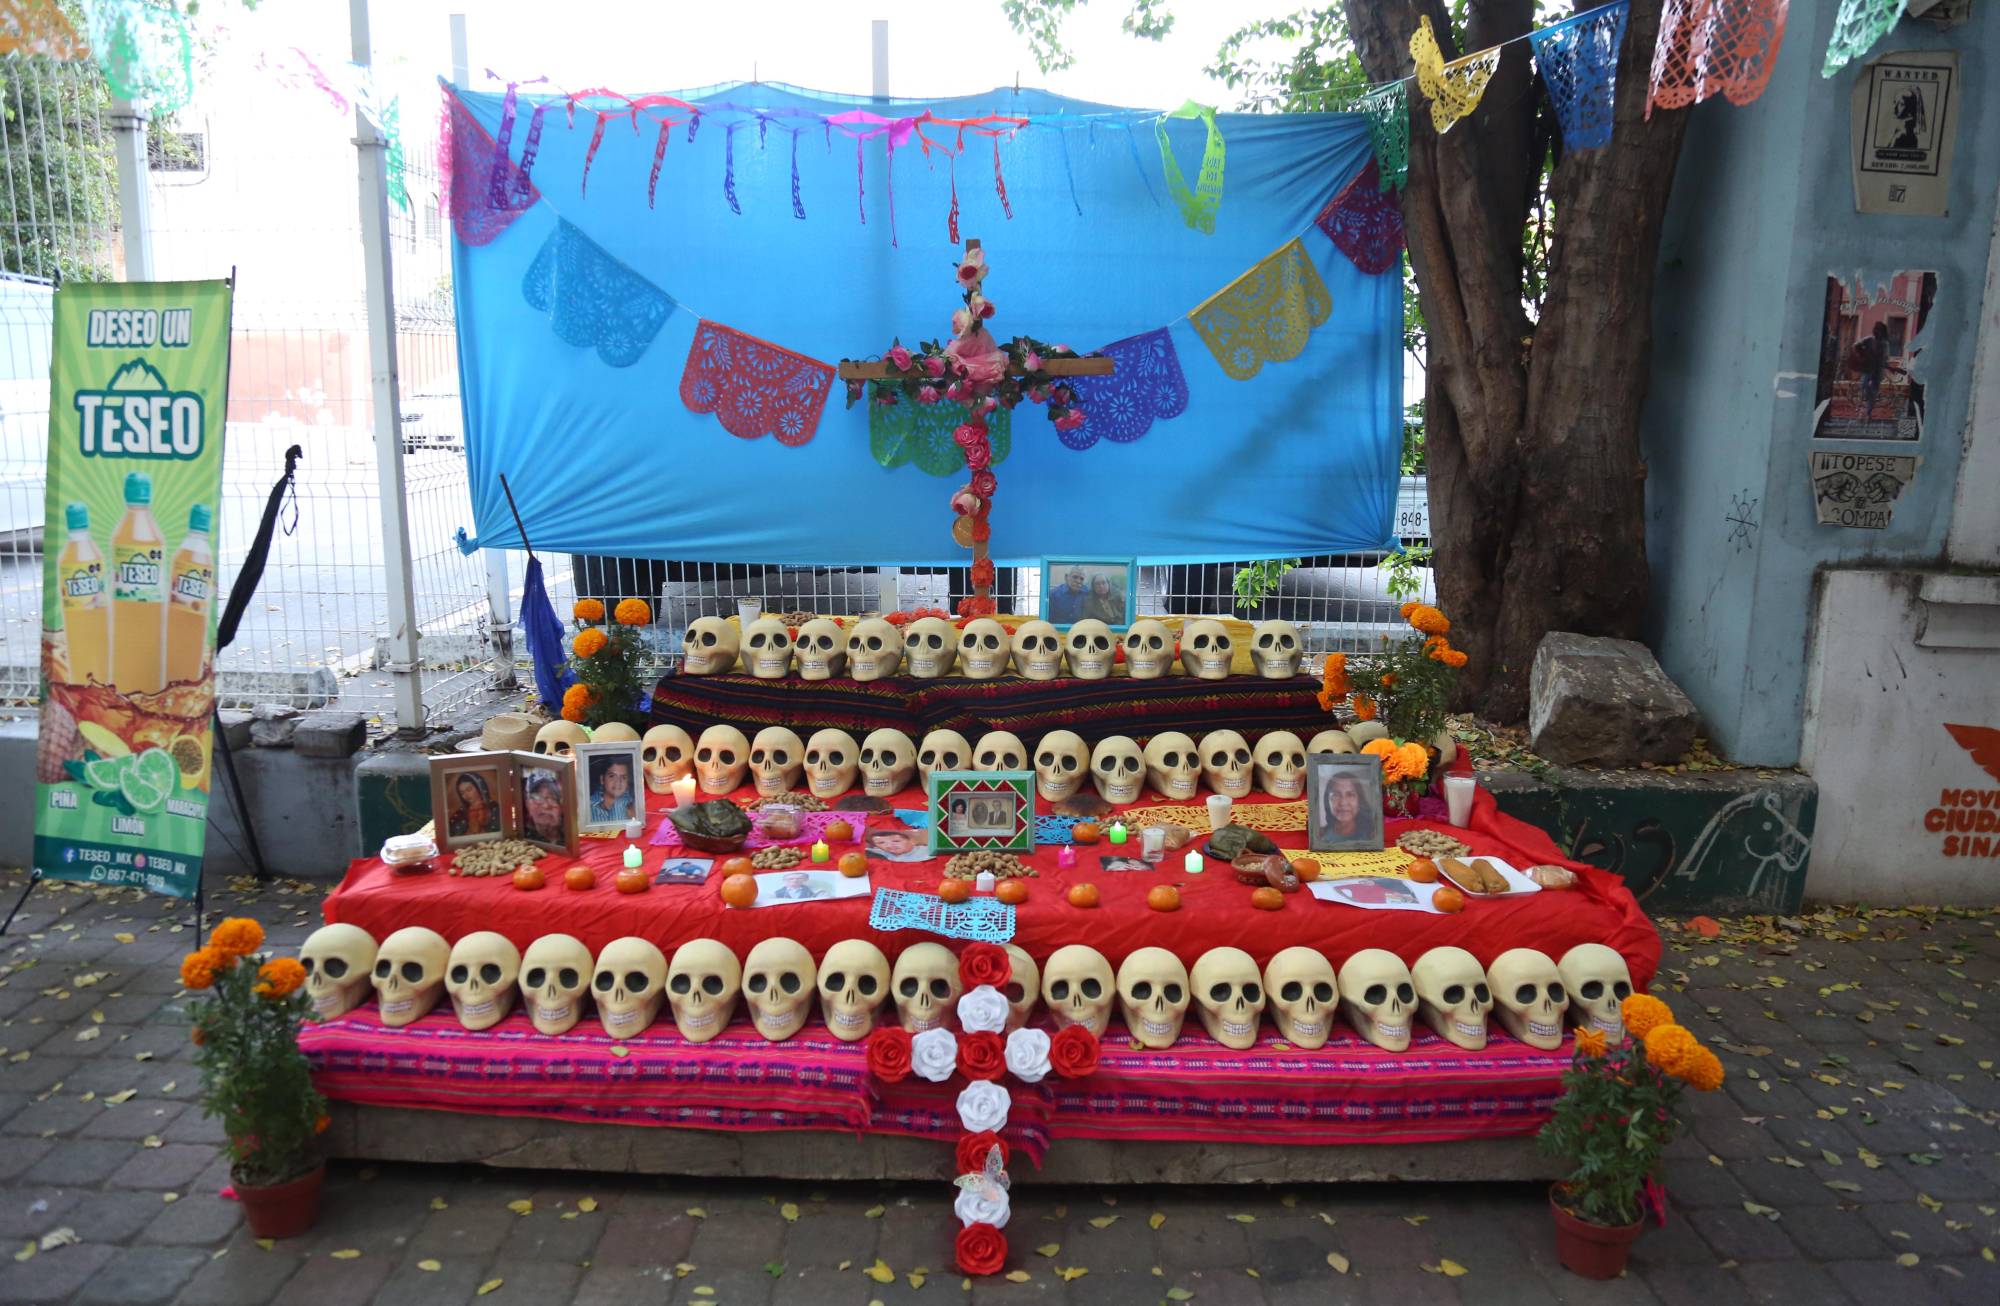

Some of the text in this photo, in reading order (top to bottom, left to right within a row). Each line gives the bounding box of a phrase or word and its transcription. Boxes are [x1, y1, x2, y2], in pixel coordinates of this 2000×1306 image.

[1884, 69, 1938, 80] WANTED
[88, 309, 192, 347] DESEO UN
[76, 394, 203, 456] TESEO
[120, 562, 159, 584] TESEO
[65, 576, 99, 597] TESEO
[51, 790, 78, 809] PIÑA
[112, 816, 145, 836] LIMÓN
